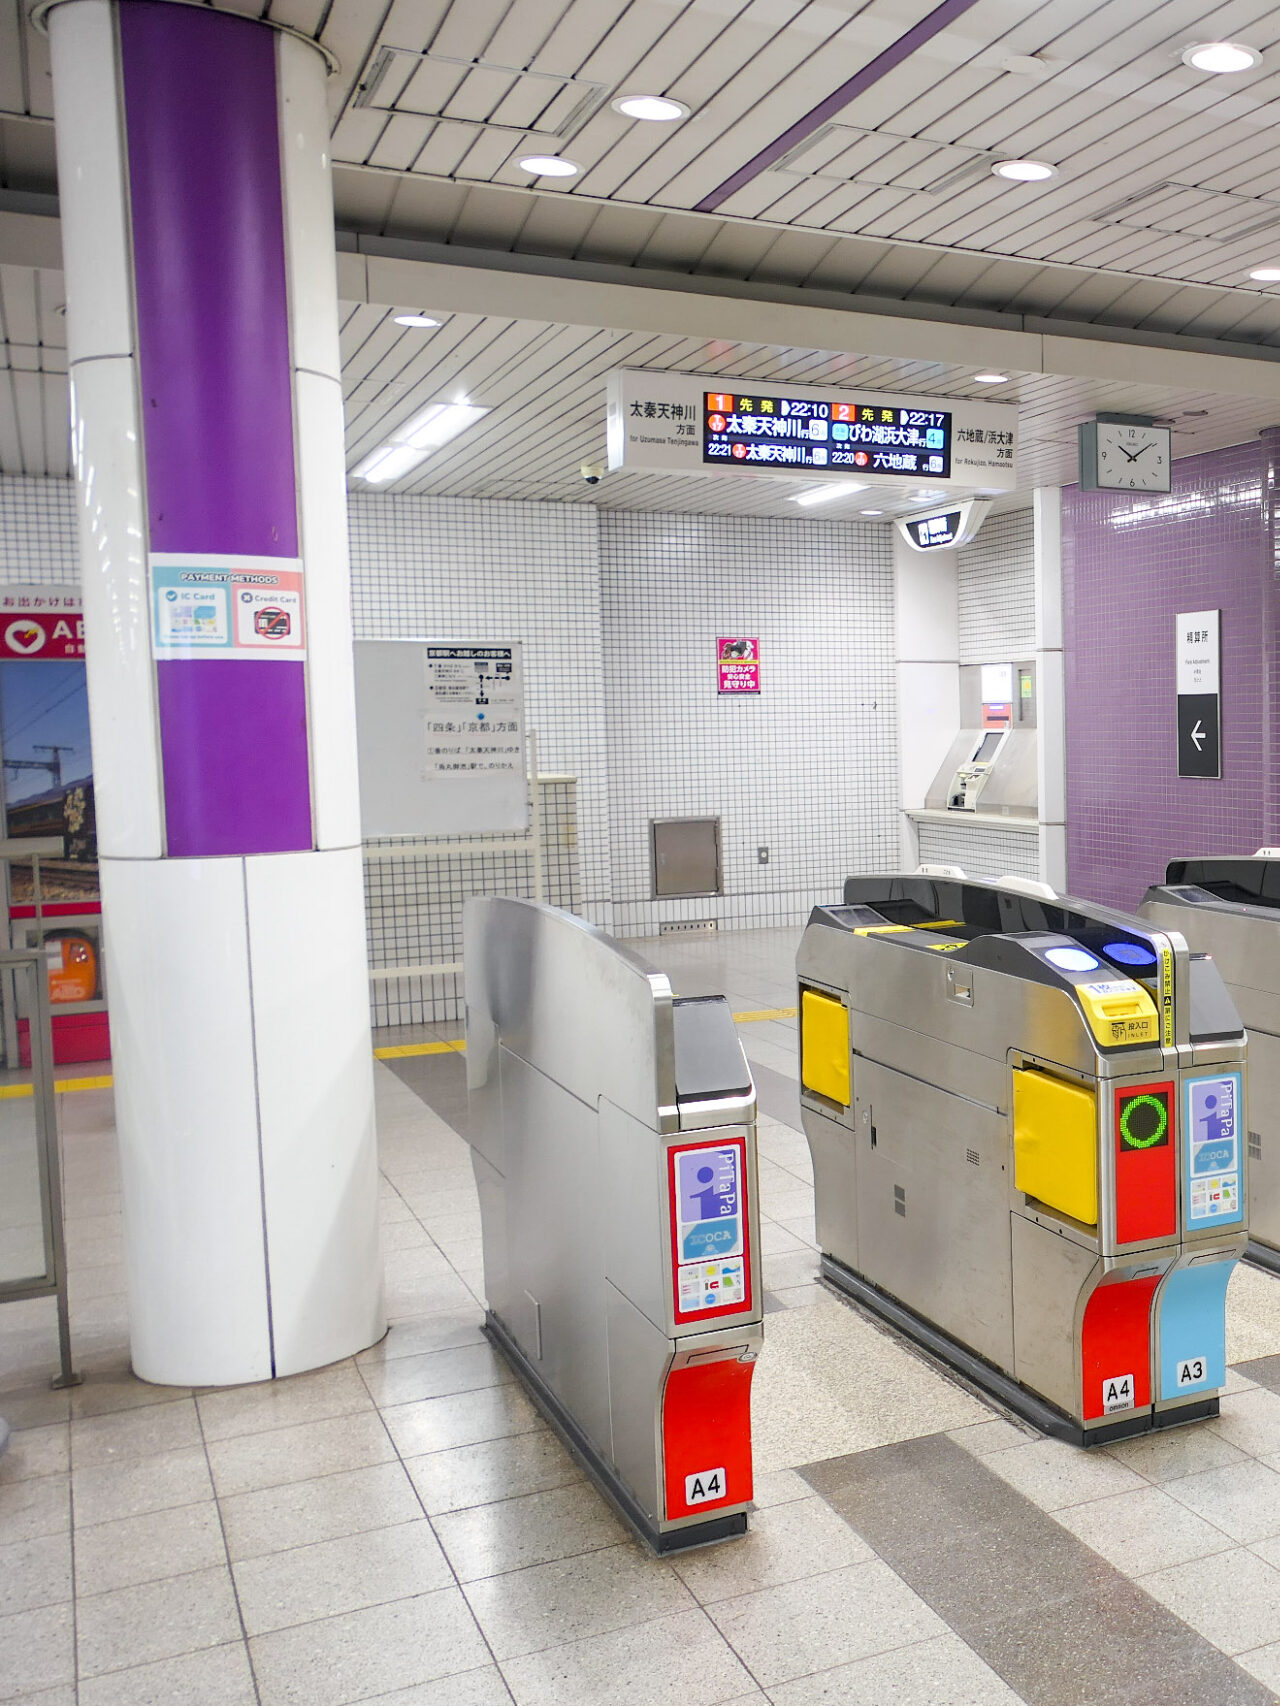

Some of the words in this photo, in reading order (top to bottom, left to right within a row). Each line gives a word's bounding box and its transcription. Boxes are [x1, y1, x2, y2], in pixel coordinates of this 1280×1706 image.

[716, 395, 724, 410] 1
[740, 398, 774, 413] 先発
[790, 402, 829, 418] 22:10
[630, 400, 696, 421] 太秦天神川
[838, 404, 850, 420] 2
[861, 408, 894, 422] 先発
[909, 411, 944, 427] 22:17
[676, 424, 696, 436] 方面
[957, 429, 1014, 446] 六地蔵/浜大津
[1128, 429, 1136, 438] 12
[996, 448, 1014, 459] 方面
[1102, 452, 1107, 460] 9
[1157, 456, 1162, 465] 3
[1130, 478, 1135, 488] 6
[180, 572, 229, 582] PAYMENT
[230, 574, 279, 584] METHODS
[280, 596, 296, 604] Card
[1128, 1022, 1149, 1031] 投入口
[1220, 1083, 1232, 1137] PiTaPa
[718, 1152, 736, 1216] PiTaPa
[1180, 1361, 1203, 1382] A3
[1107, 1380, 1130, 1402] A4
[691, 1474, 720, 1500] A4
